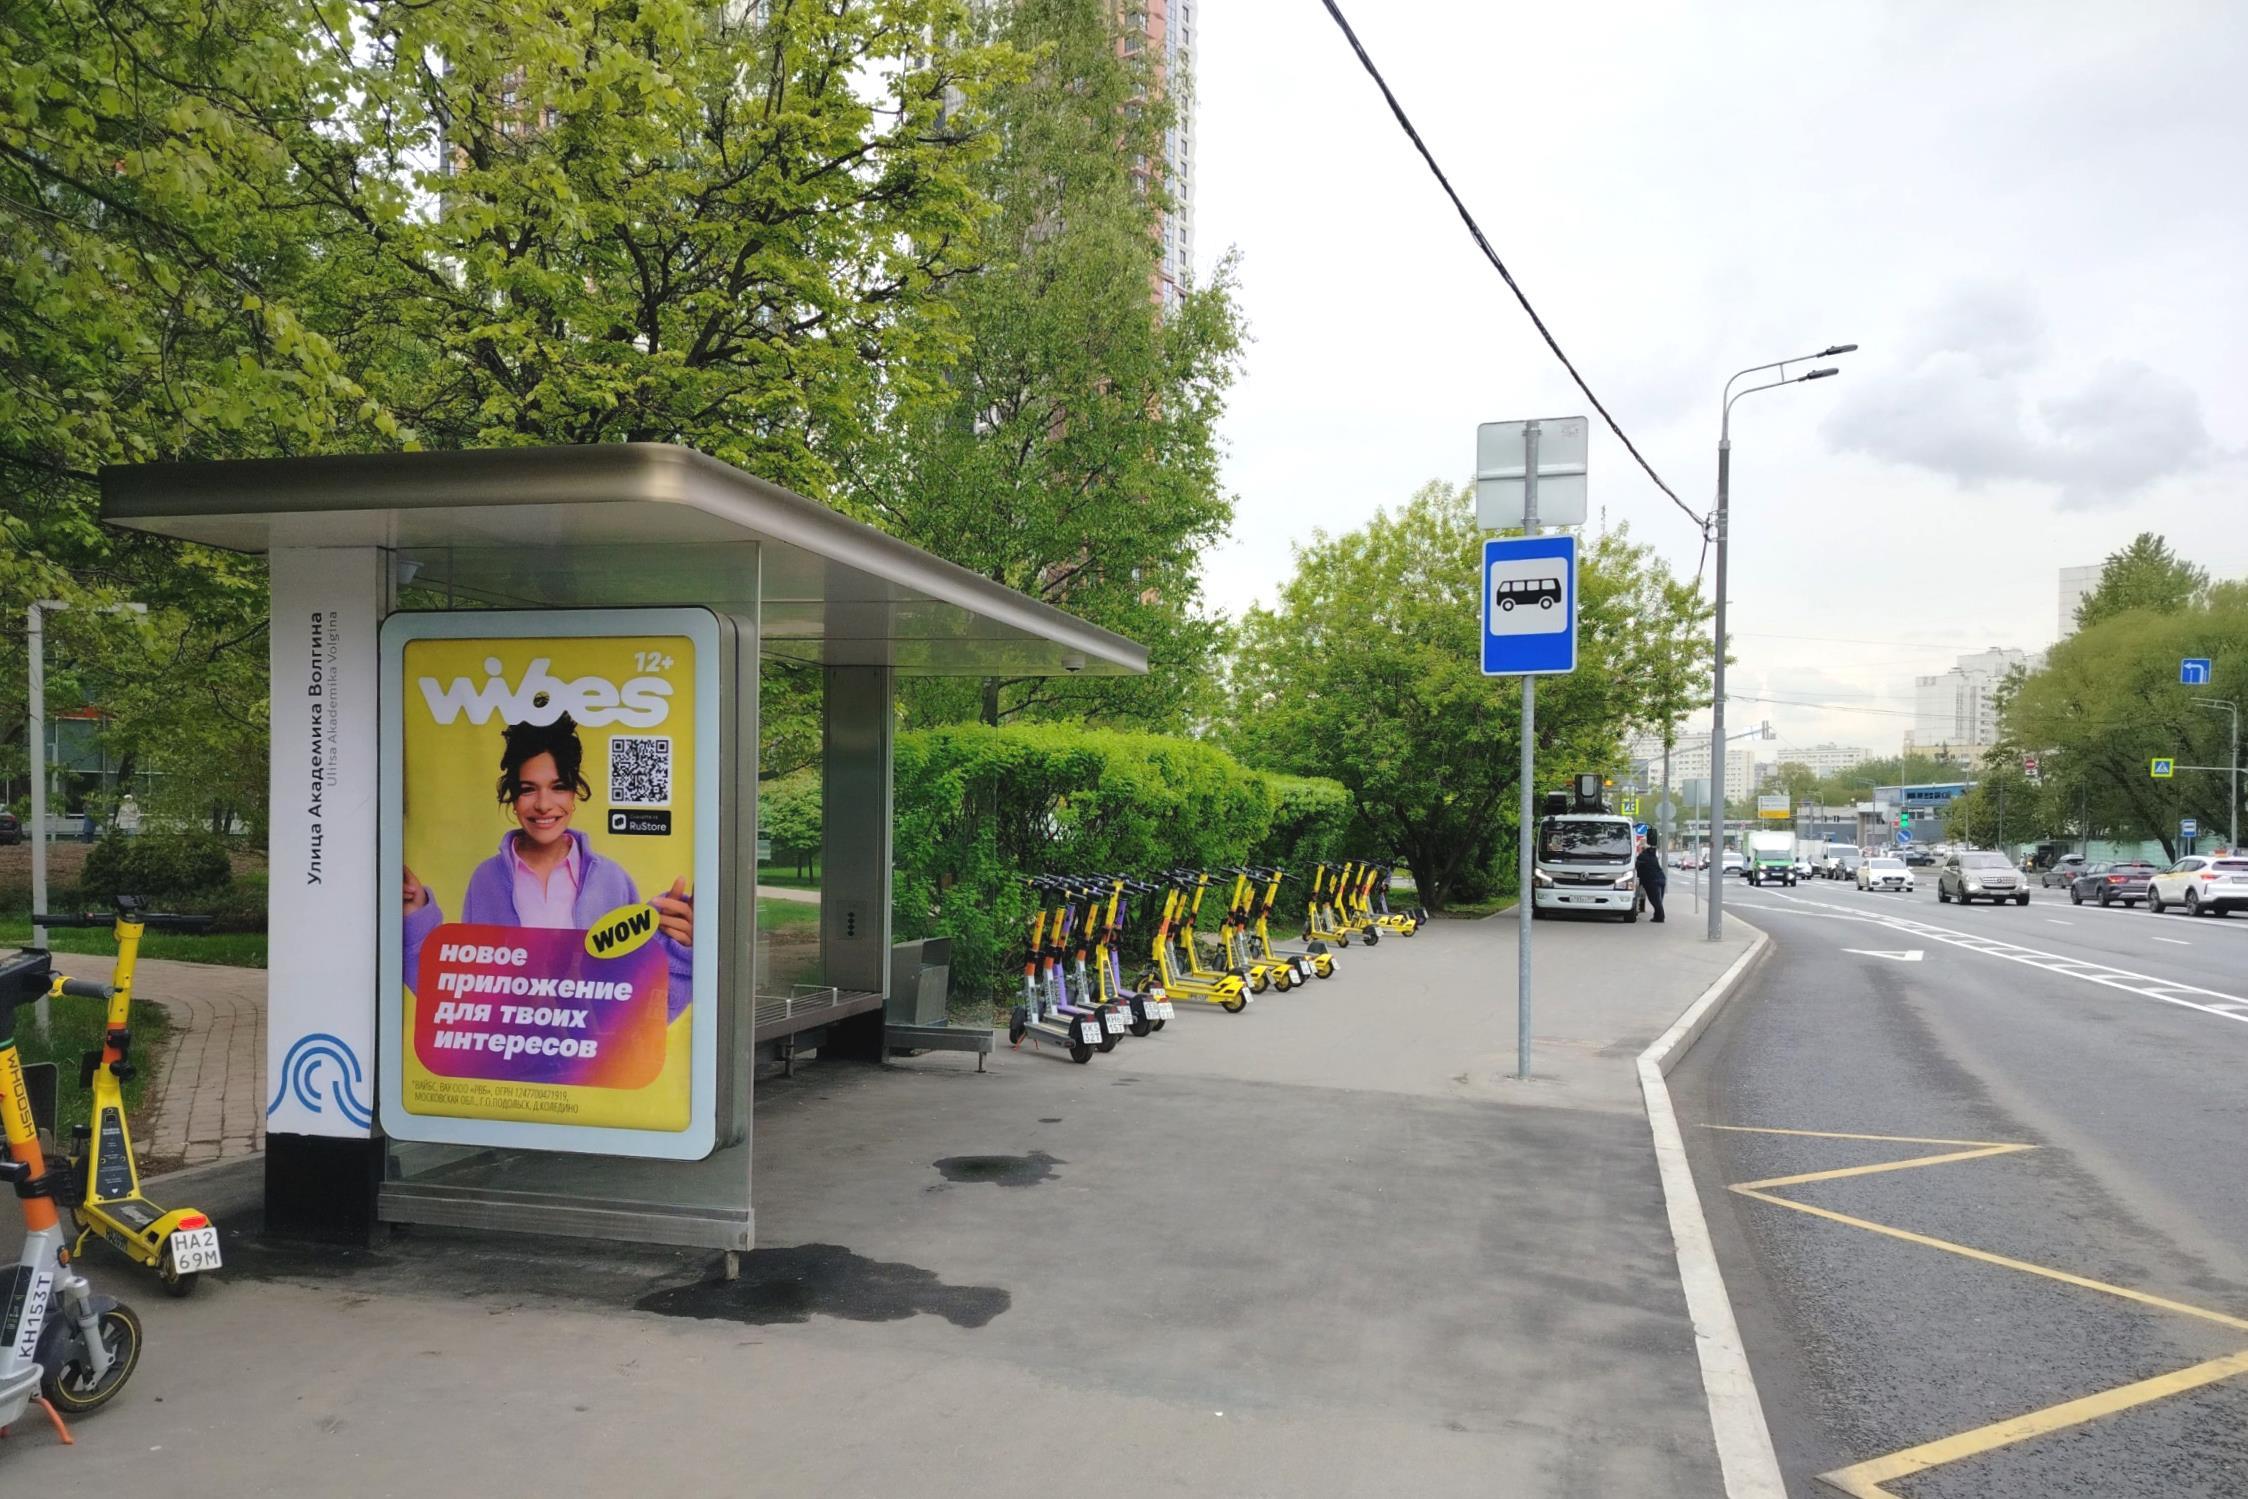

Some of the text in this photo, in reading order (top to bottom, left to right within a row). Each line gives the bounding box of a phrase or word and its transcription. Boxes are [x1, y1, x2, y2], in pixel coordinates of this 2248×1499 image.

[634, 651, 675, 673] 12+
[326, 612, 339, 787] Ulitsa Akademika Volgina
[417, 656, 674, 729] wibes
[307, 612, 325, 886] Улица Академика Волгина
[629, 820, 668, 833] RuStore
[438, 943, 529, 967] новое
[436, 971, 634, 1002] приложение
[433, 1001, 589, 1029] для твоих
[432, 1030, 599, 1061] интересов
[6, 1053, 37, 1139] WHOOSH
